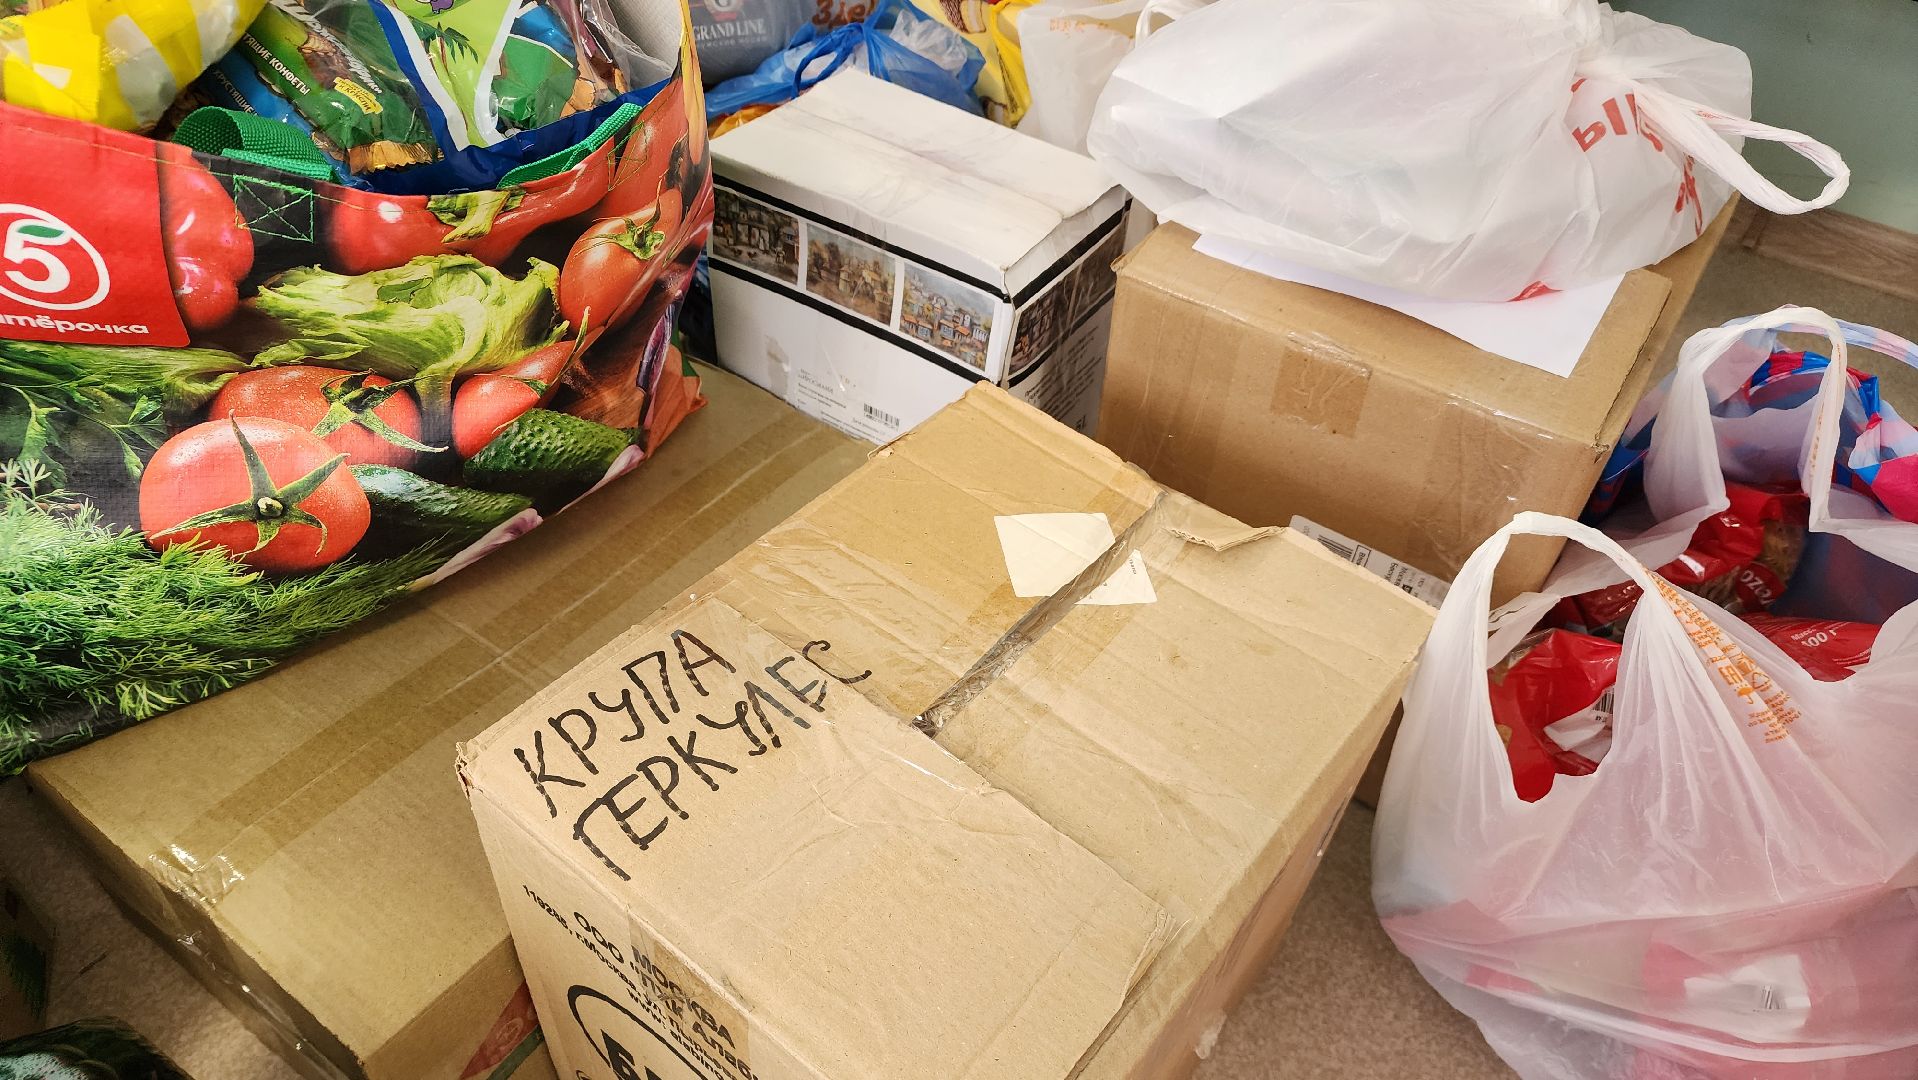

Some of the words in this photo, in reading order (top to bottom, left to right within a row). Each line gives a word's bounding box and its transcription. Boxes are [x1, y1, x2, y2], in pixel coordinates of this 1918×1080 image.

[243, 33, 273, 61] ТЯЩИЕ
[269, 57, 311, 96] КОНФЕТЫ
[693, 22, 735, 41] GRAND
[736, 18, 766, 36] LINE
[4, 219, 71, 294] 5
[514, 630, 737, 818] КРУПА
[572, 639, 873, 881] ГЕРКУЛЕС
[573, 911, 625, 964] ООО
[631, 944, 736, 1050] МОСКВА
